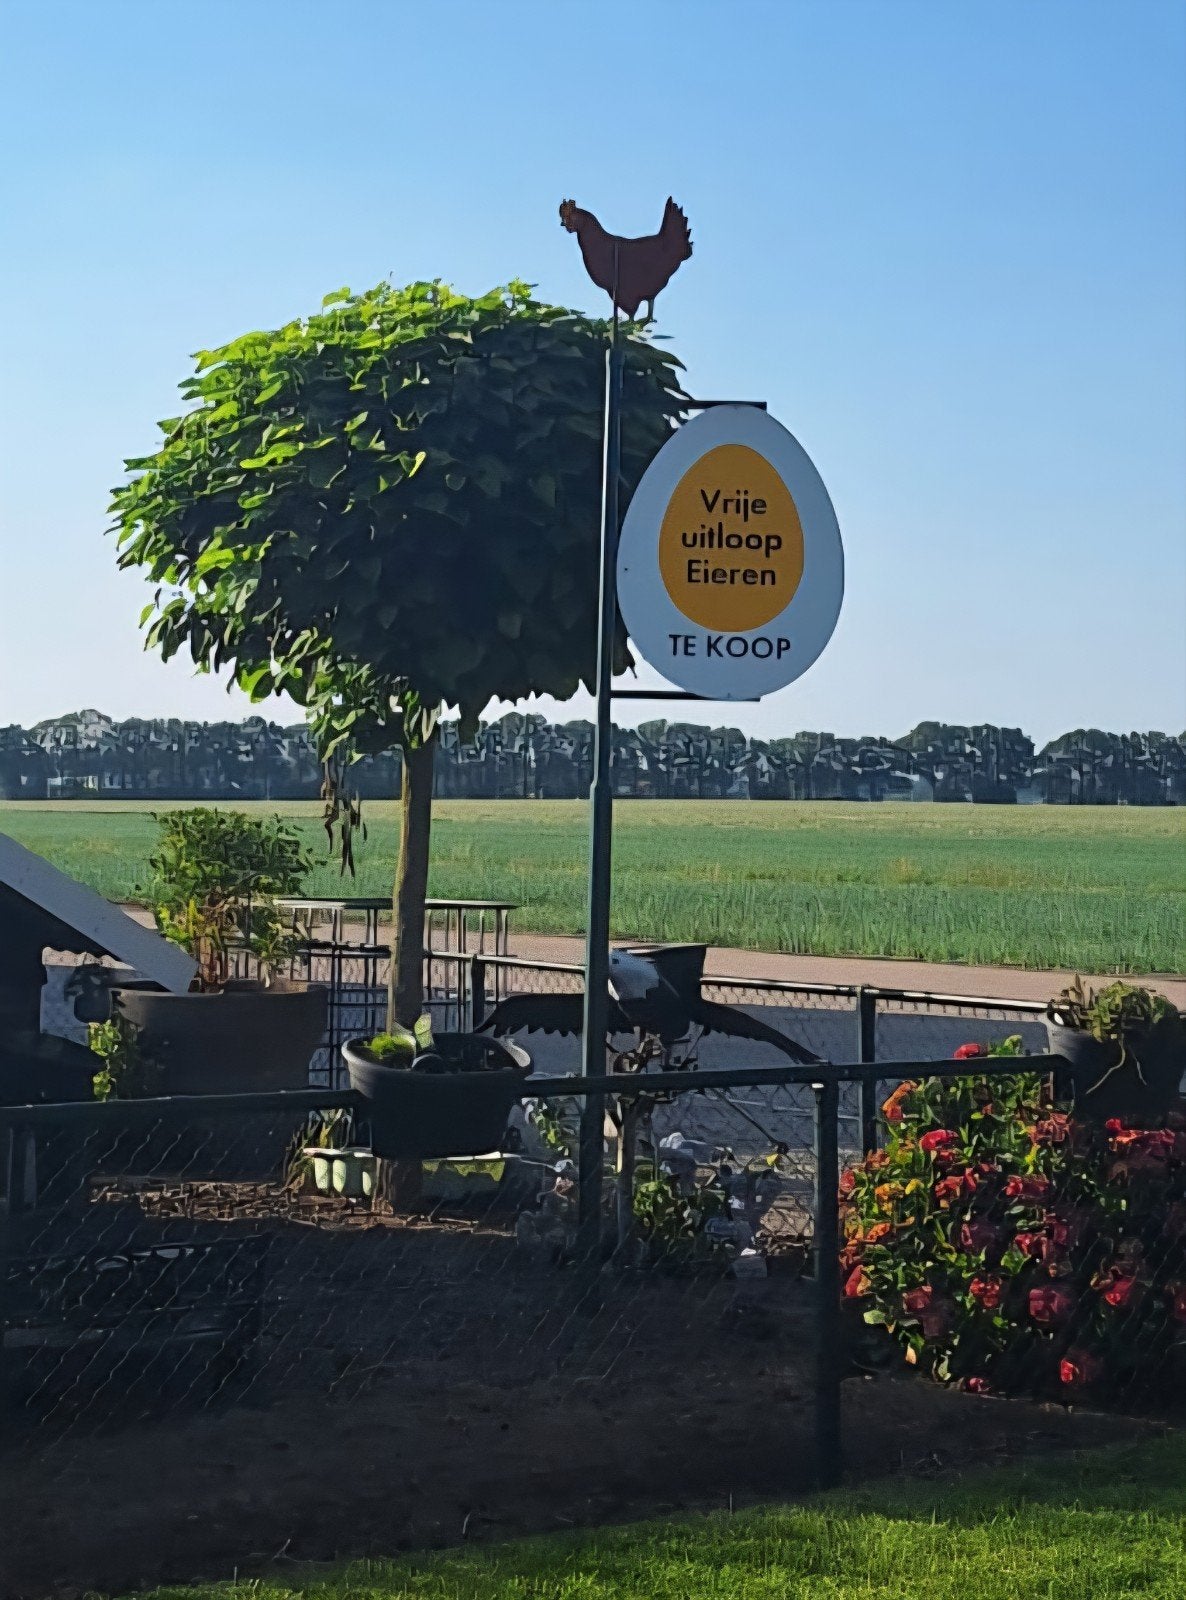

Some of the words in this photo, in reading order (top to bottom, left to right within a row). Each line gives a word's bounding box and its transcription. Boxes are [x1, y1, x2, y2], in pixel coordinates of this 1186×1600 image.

[700, 488, 768, 523] Vrije
[681, 521, 783, 559] uitloop
[686, 559, 777, 587] Eieren
[668, 634, 697, 657] TE
[706, 635, 791, 660] KOOP
